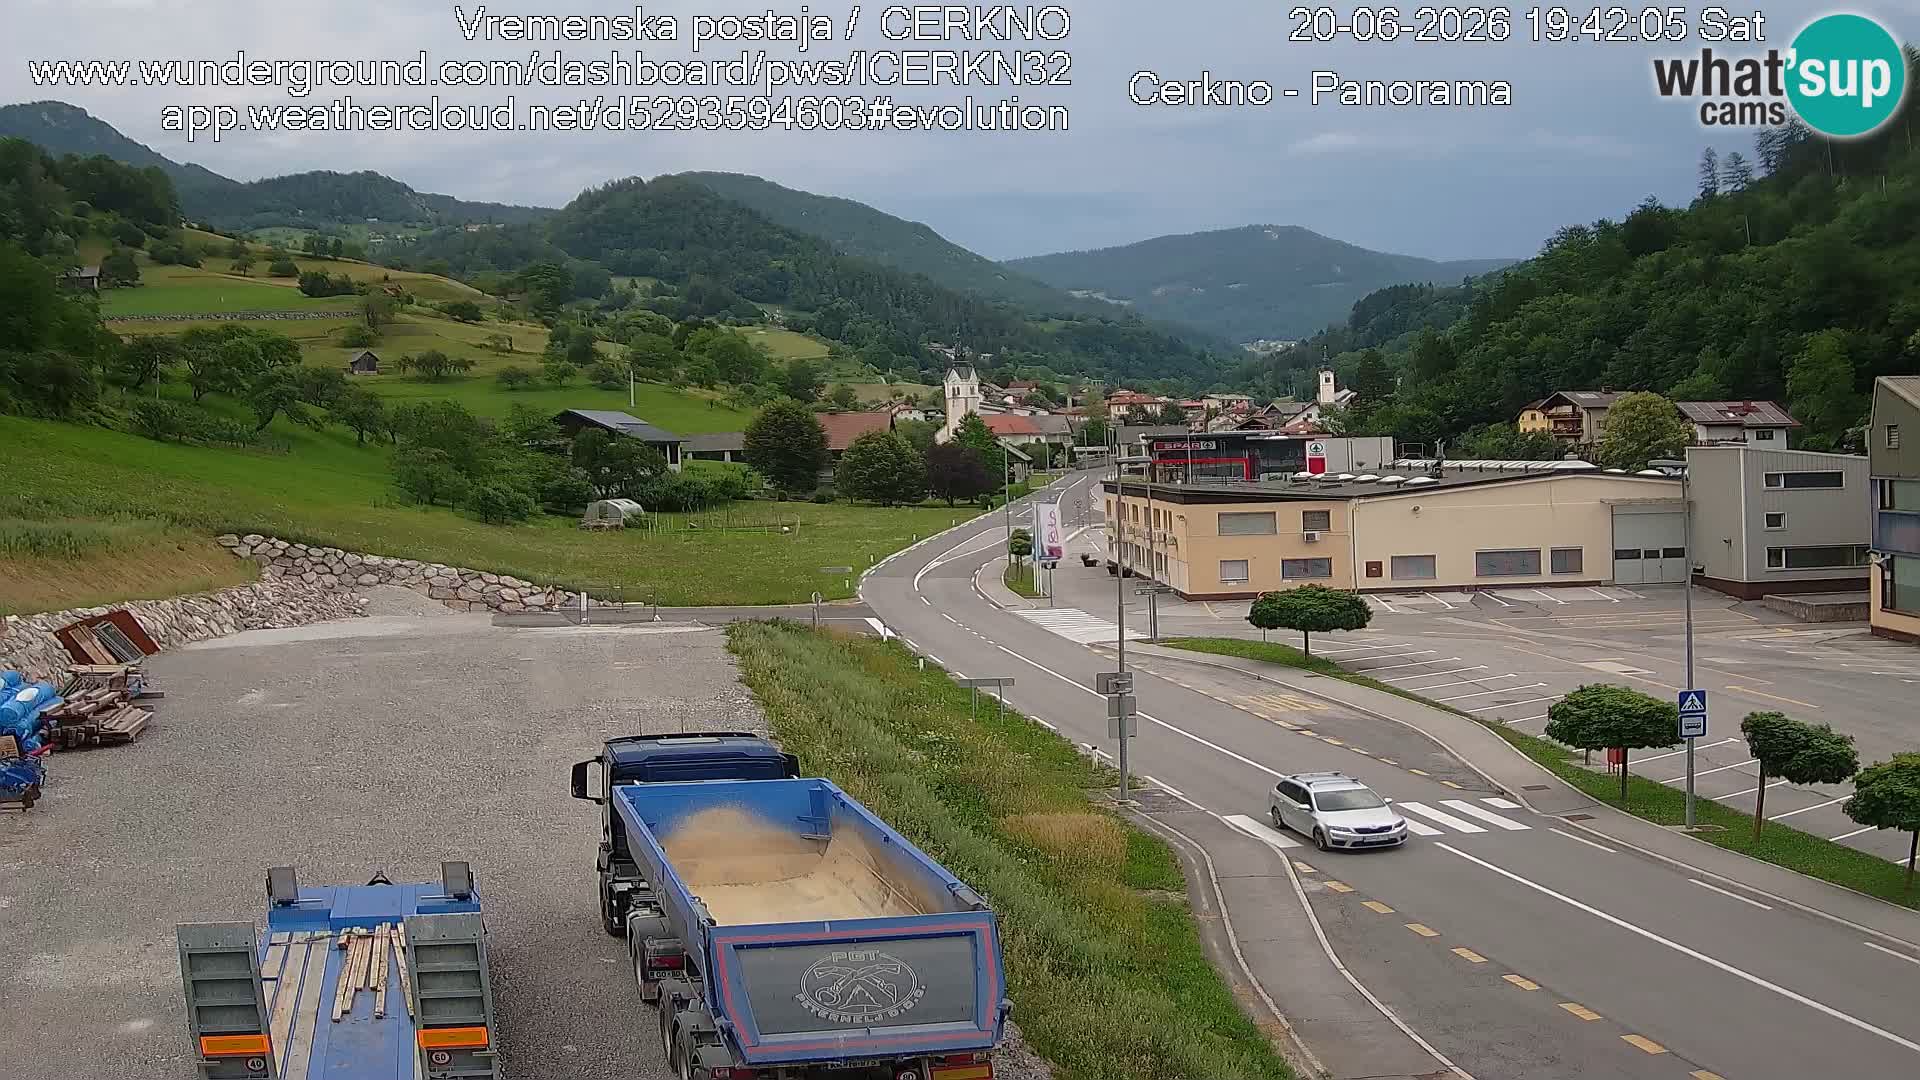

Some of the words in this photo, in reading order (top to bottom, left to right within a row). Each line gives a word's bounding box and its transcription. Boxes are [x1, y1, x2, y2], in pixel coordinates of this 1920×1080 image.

[794, 993, 884, 1024] PETERNELJ
[434, 1052, 447, 1063] 60
[249, 1058, 262, 1069] 40
